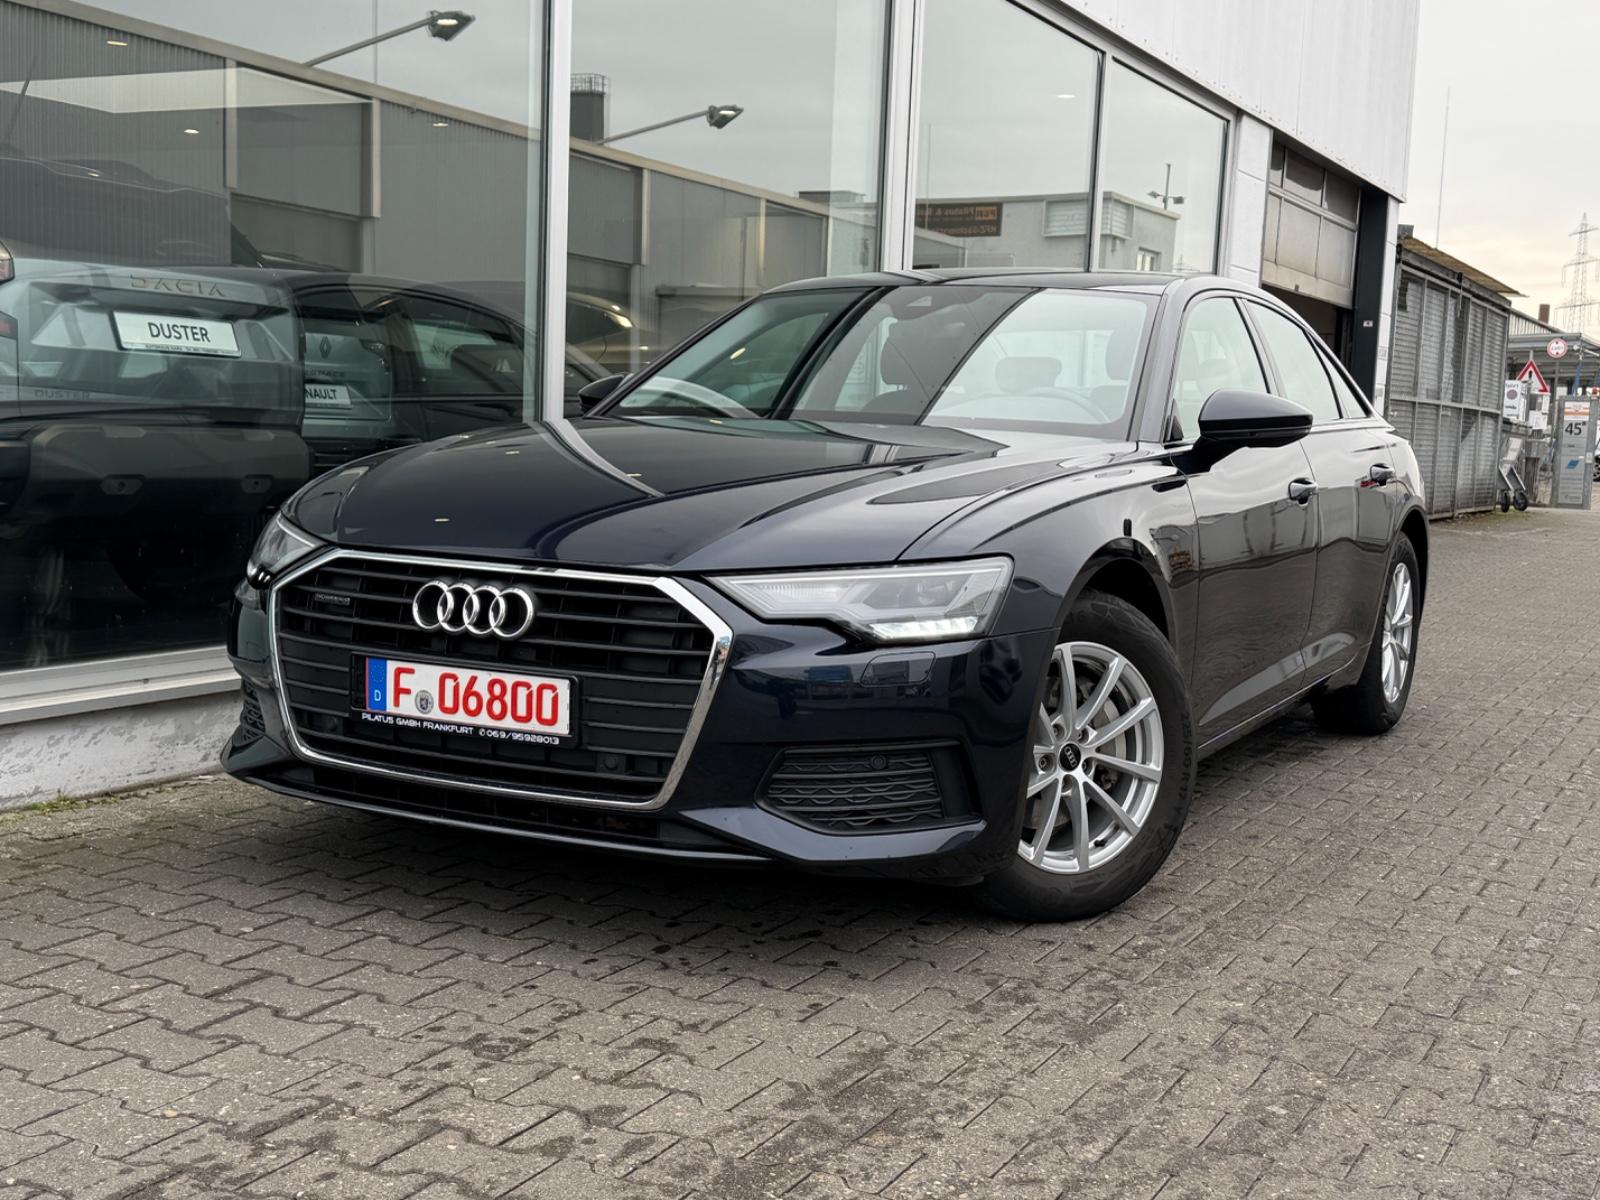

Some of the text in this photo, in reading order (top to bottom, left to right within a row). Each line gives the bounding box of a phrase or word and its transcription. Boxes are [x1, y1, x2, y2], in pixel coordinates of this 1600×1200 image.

[130, 274, 225, 297] DACIA
[148, 322, 211, 343] DUSTER
[305, 388, 337, 400] NAULT
[374, 689, 382, 702] D
[393, 666, 559, 726] F 06800
[361, 712, 394, 725] PILATUS
[423, 721, 475, 735] FRANKFURT
